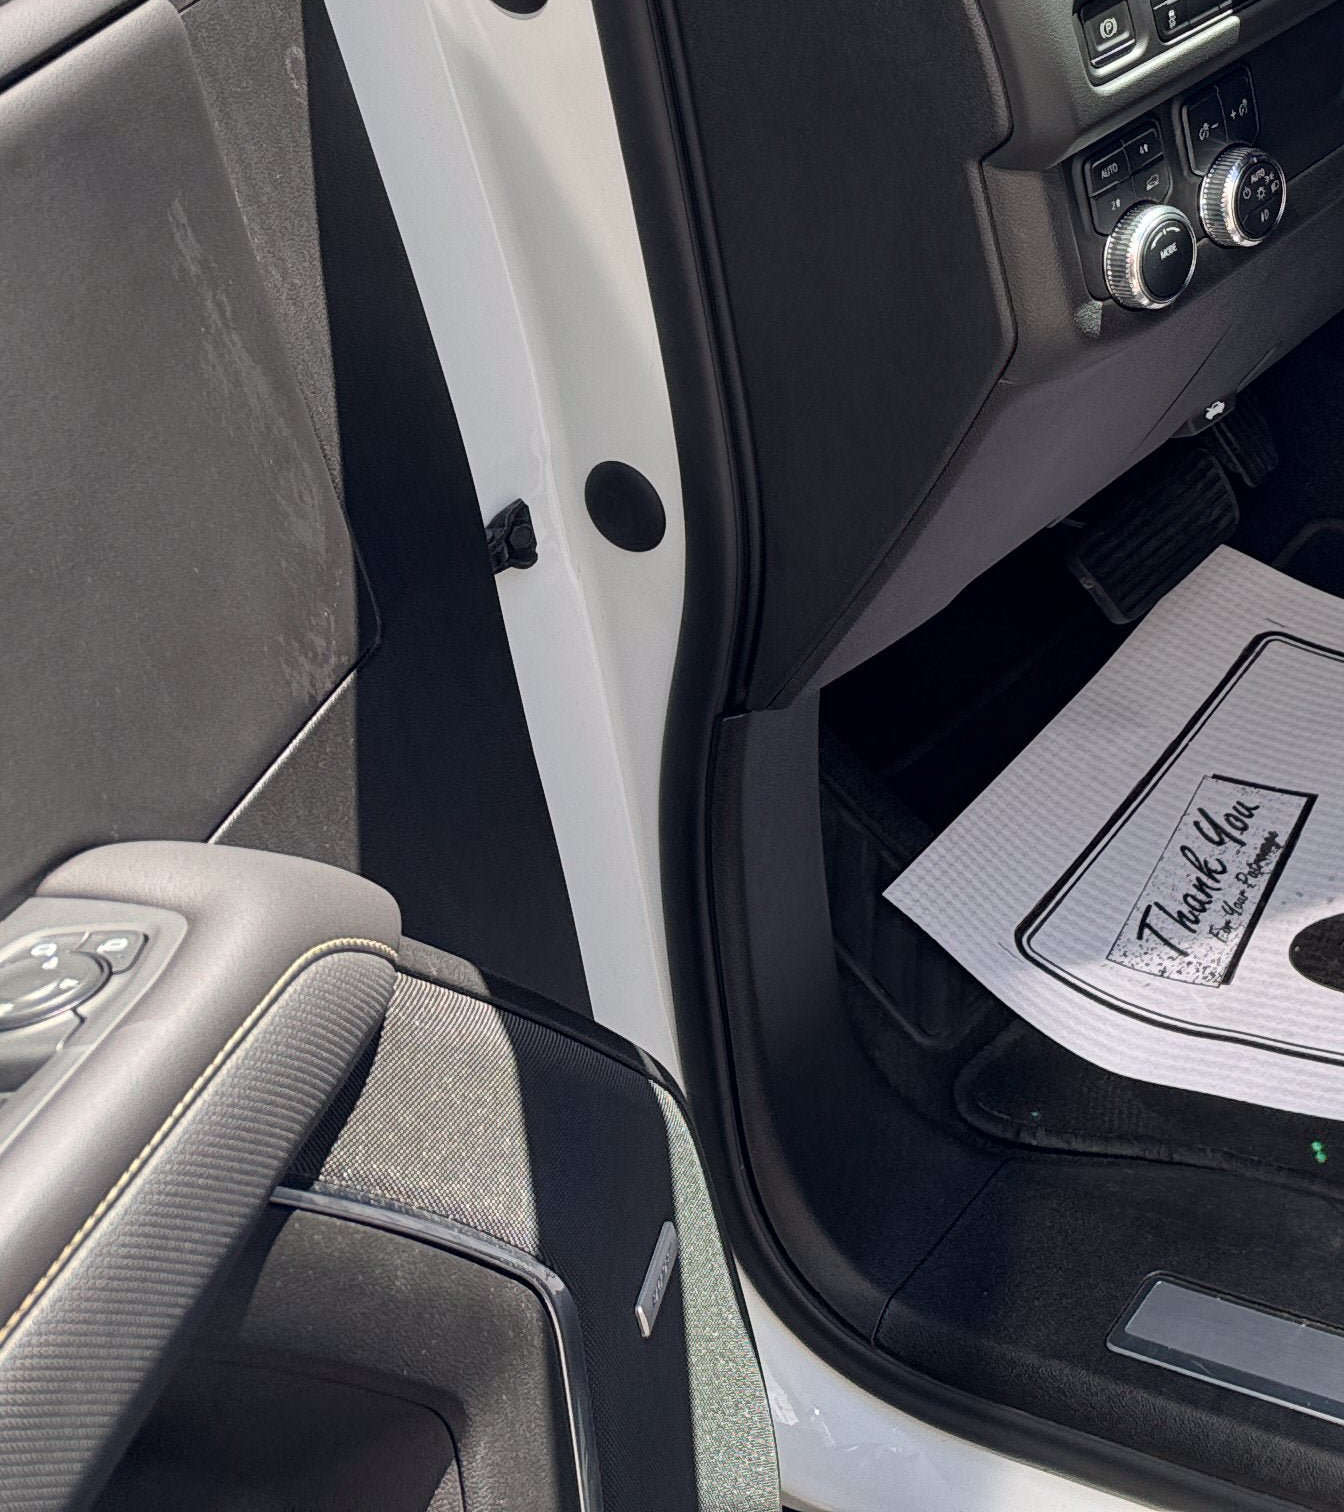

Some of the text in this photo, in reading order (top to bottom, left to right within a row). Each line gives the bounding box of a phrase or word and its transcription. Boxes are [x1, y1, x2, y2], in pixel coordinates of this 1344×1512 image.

[1101, 162, 1119, 179] AUTO
[1159, 241, 1178, 261] MODE
[1136, 800, 1260, 957] Thank You
[1221, 889, 1249, 916] Your
[1209, 919, 1234, 943] For
